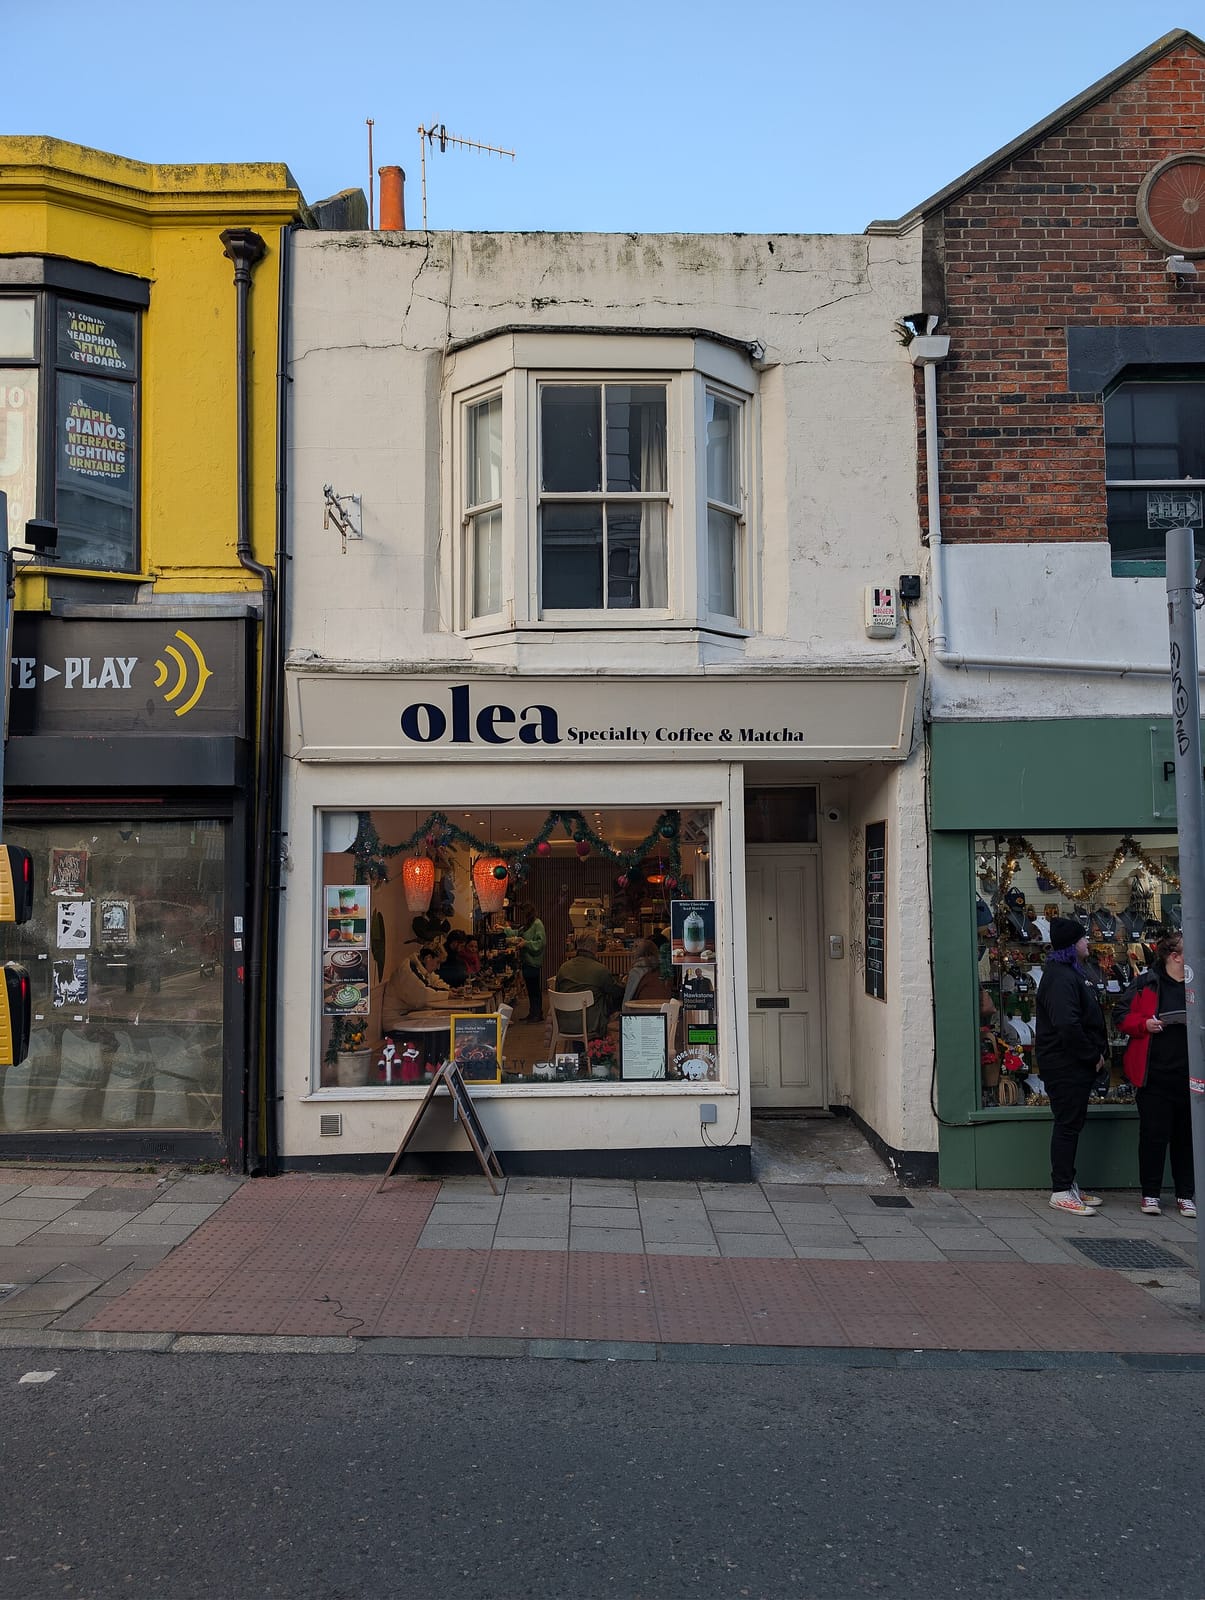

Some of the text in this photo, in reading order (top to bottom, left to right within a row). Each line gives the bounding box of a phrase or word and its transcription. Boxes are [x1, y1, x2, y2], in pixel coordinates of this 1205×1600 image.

[65, 416, 126, 440] PIANOS
[64, 444, 126, 463] LIGHTING
[64, 657, 138, 689] PLAY
[400, 684, 804, 744] olea Specialty Coffee & Matcha
[672, 1050, 689, 1064] DOGS
